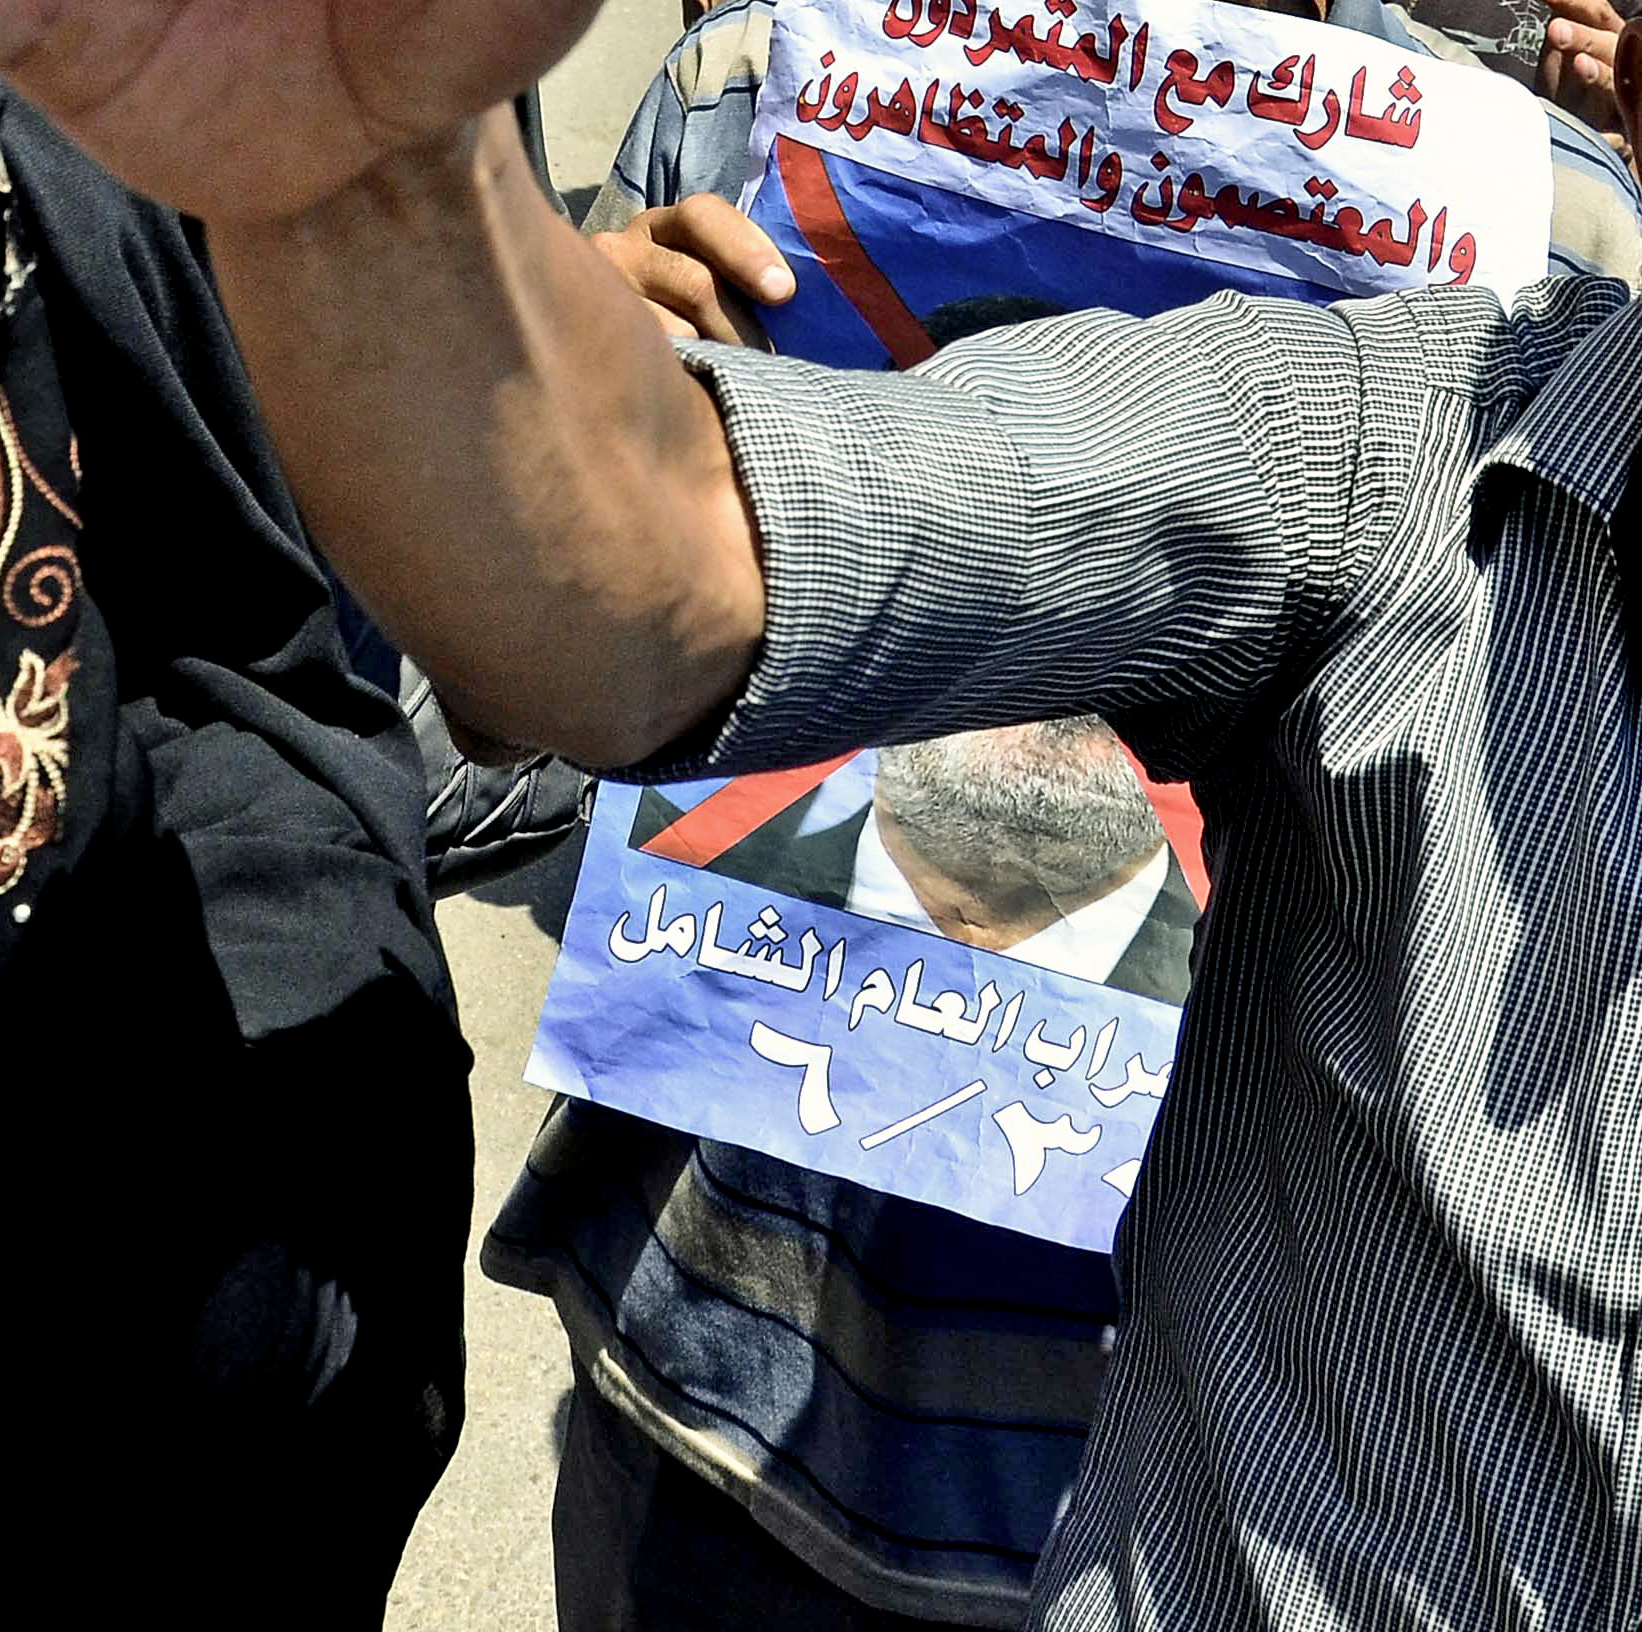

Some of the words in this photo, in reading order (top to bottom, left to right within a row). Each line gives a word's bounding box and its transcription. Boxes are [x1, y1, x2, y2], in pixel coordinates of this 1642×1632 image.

[795, 49, 1124, 214] والمتظاهرون
[1154, 48, 1237, 135] مع
[1246, 55, 1424, 150] شارك
[1129, 151, 1478, 288] والمعتصمون
[609, 884, 846, 1000] الشامل
[848, 960, 1024, 1052] العام
